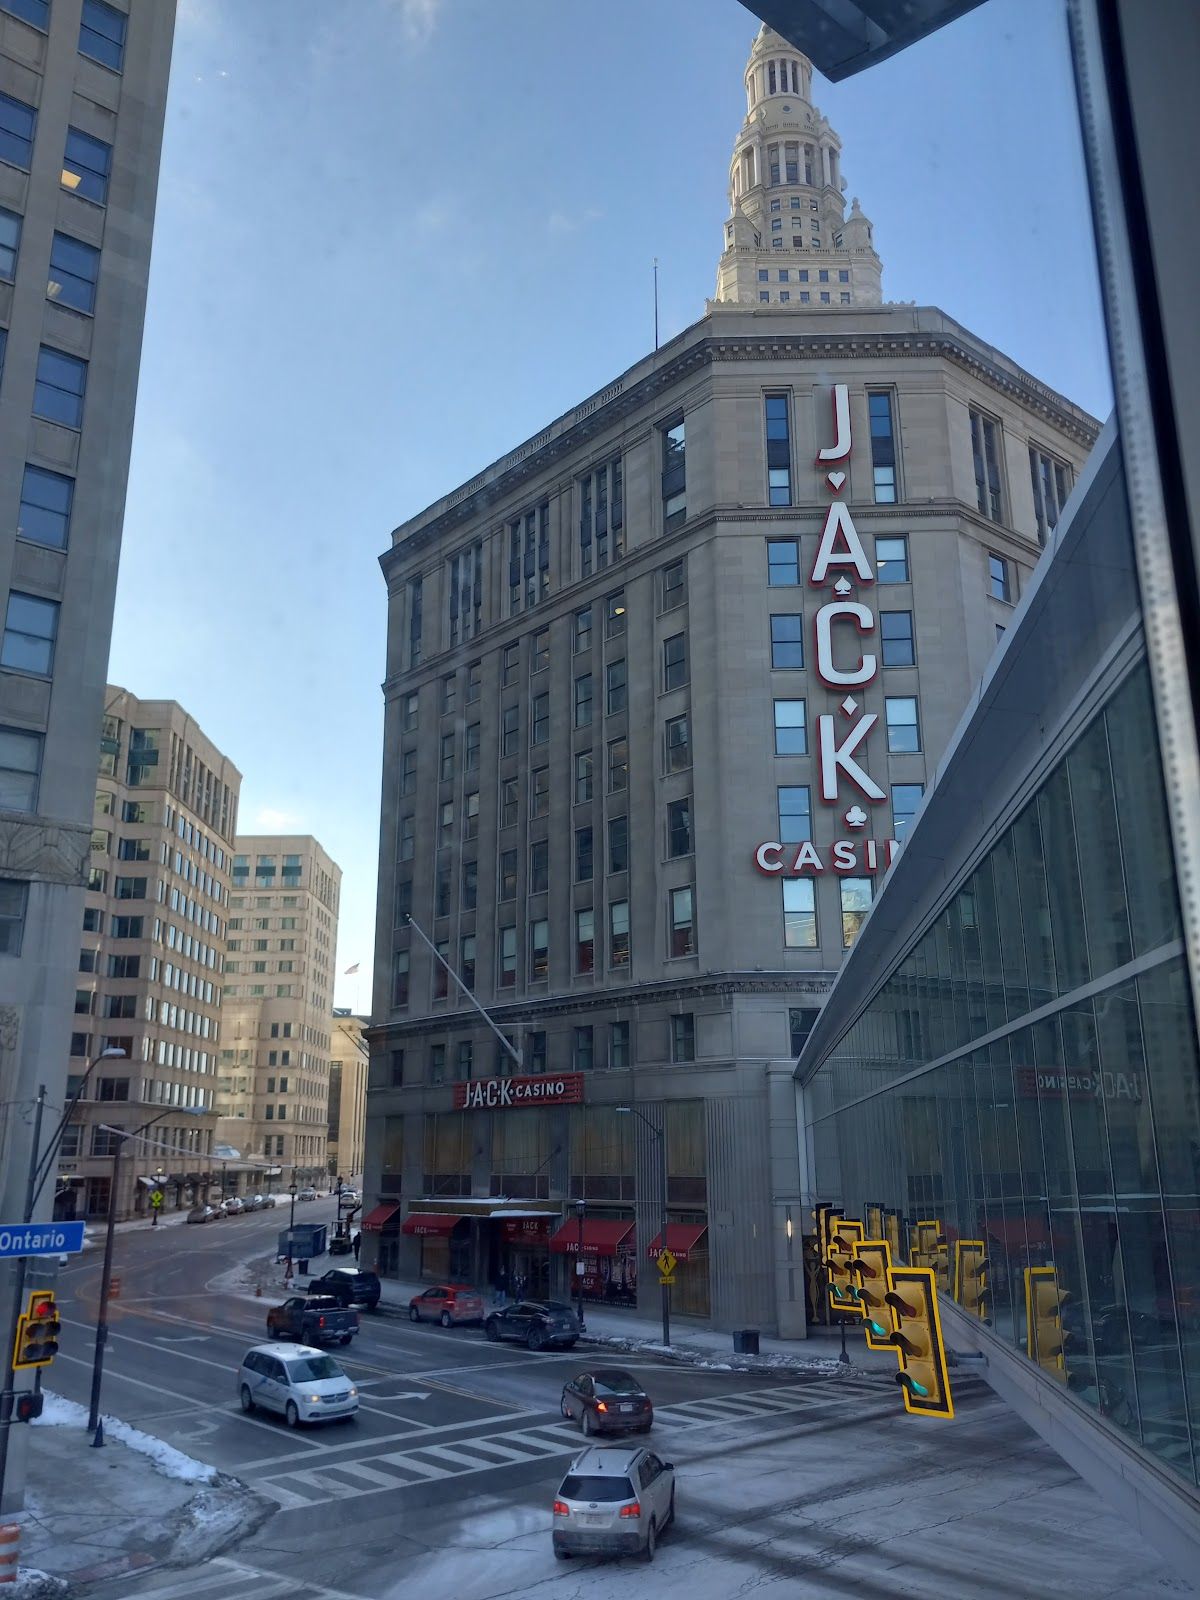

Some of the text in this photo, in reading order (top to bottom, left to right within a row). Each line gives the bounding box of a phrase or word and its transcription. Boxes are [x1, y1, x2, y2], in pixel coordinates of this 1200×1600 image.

[811, 384, 887, 801] JACK
[463, 1079, 565, 1108] JACK CASINO
[0, 1229, 65, 1251] Ontario
[566, 1242, 581, 1251] JAC
[649, 1248, 663, 1257] JAC
